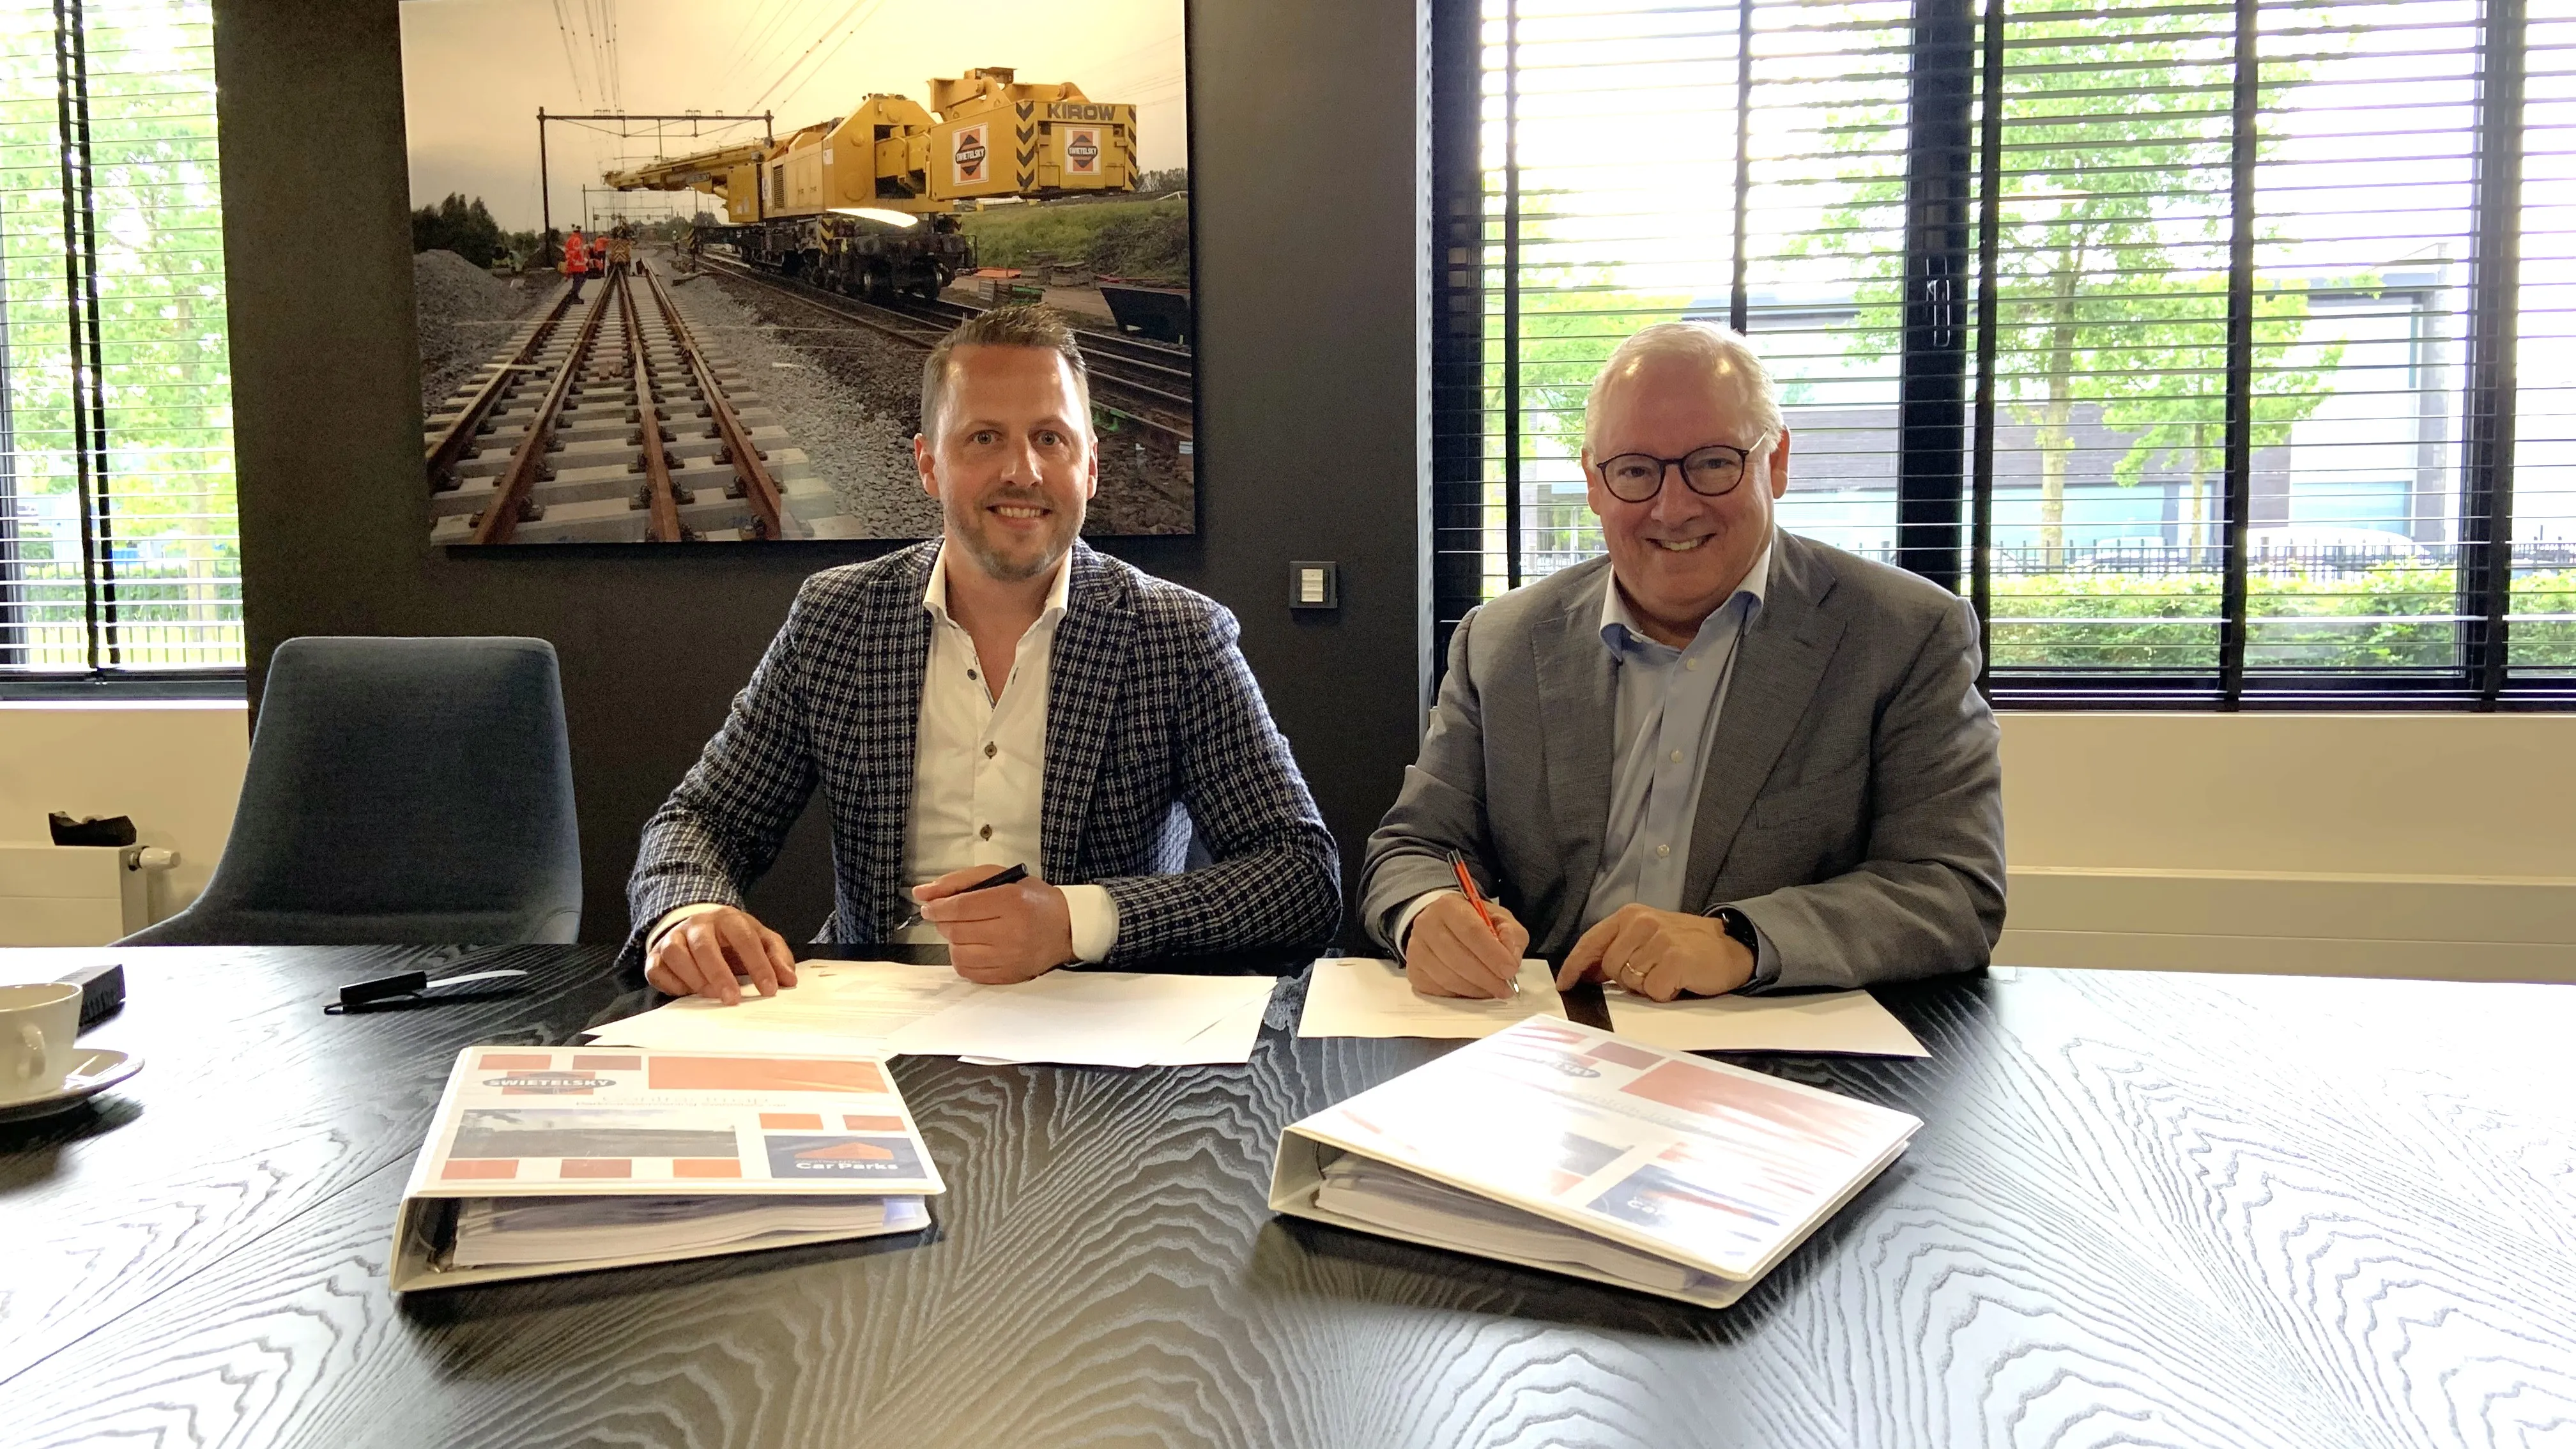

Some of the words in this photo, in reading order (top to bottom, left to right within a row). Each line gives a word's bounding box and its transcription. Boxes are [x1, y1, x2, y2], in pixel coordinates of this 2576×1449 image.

[1047, 103, 1116, 121] KIROW
[956, 148, 985, 162] SWIETELSKY
[838, 1162, 899, 1170] Parks
